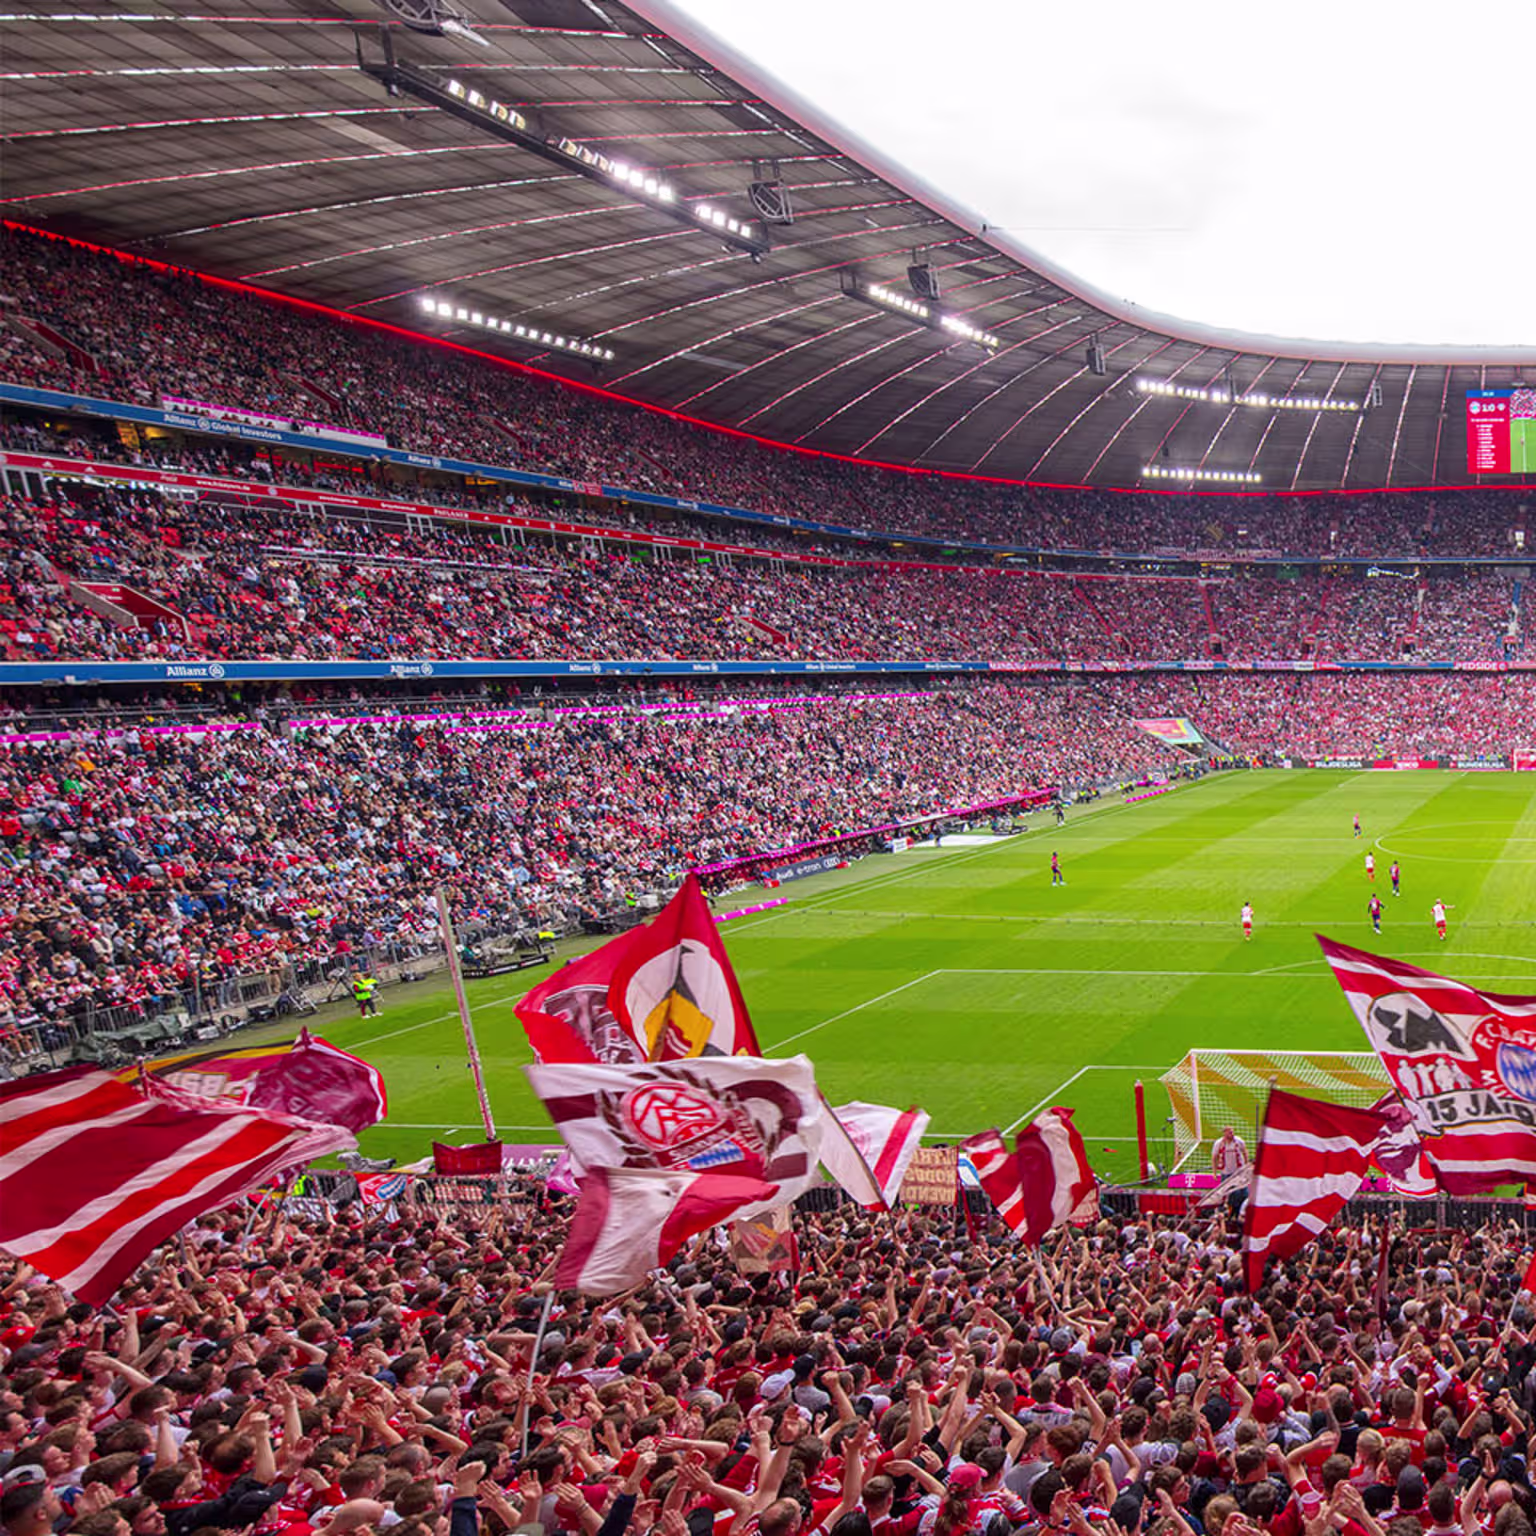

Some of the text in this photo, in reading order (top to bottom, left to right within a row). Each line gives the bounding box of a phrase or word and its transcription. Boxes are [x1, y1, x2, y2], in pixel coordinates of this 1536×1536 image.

[211, 421, 241, 434] Global
[241, 426, 282, 441] Investors
[167, 665, 208, 677] Allianz
[390, 664, 420, 675] Allianz
[569, 663, 591, 673] Allianz
[1427, 1097, 1458, 1122] 15
